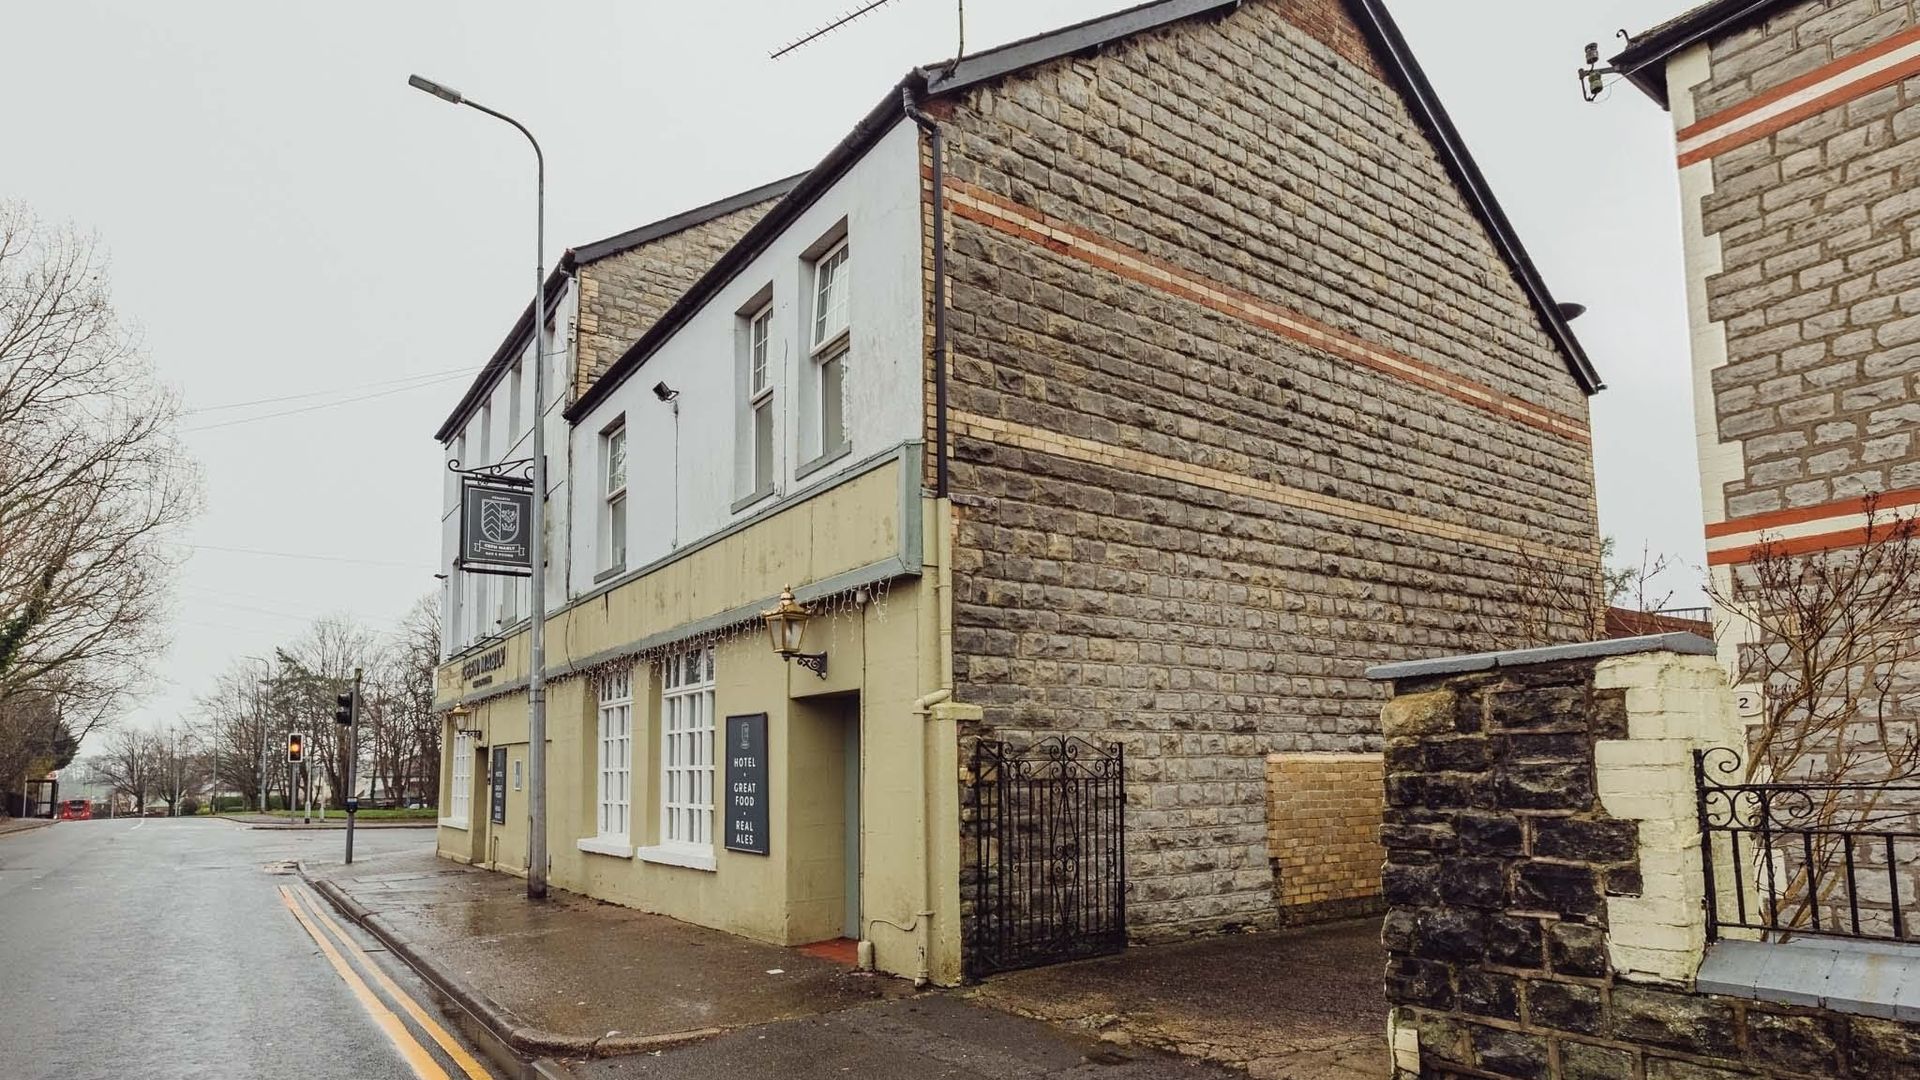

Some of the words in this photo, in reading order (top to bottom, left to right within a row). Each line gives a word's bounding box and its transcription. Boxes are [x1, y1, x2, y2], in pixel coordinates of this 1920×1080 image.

[1739, 697, 1750, 709] 2
[734, 757, 756, 767] HOTEL
[734, 783, 756, 793] GREAT
[735, 796, 755, 806] FOOD
[735, 820, 753, 831] REAL
[735, 833, 753, 845] ALES
